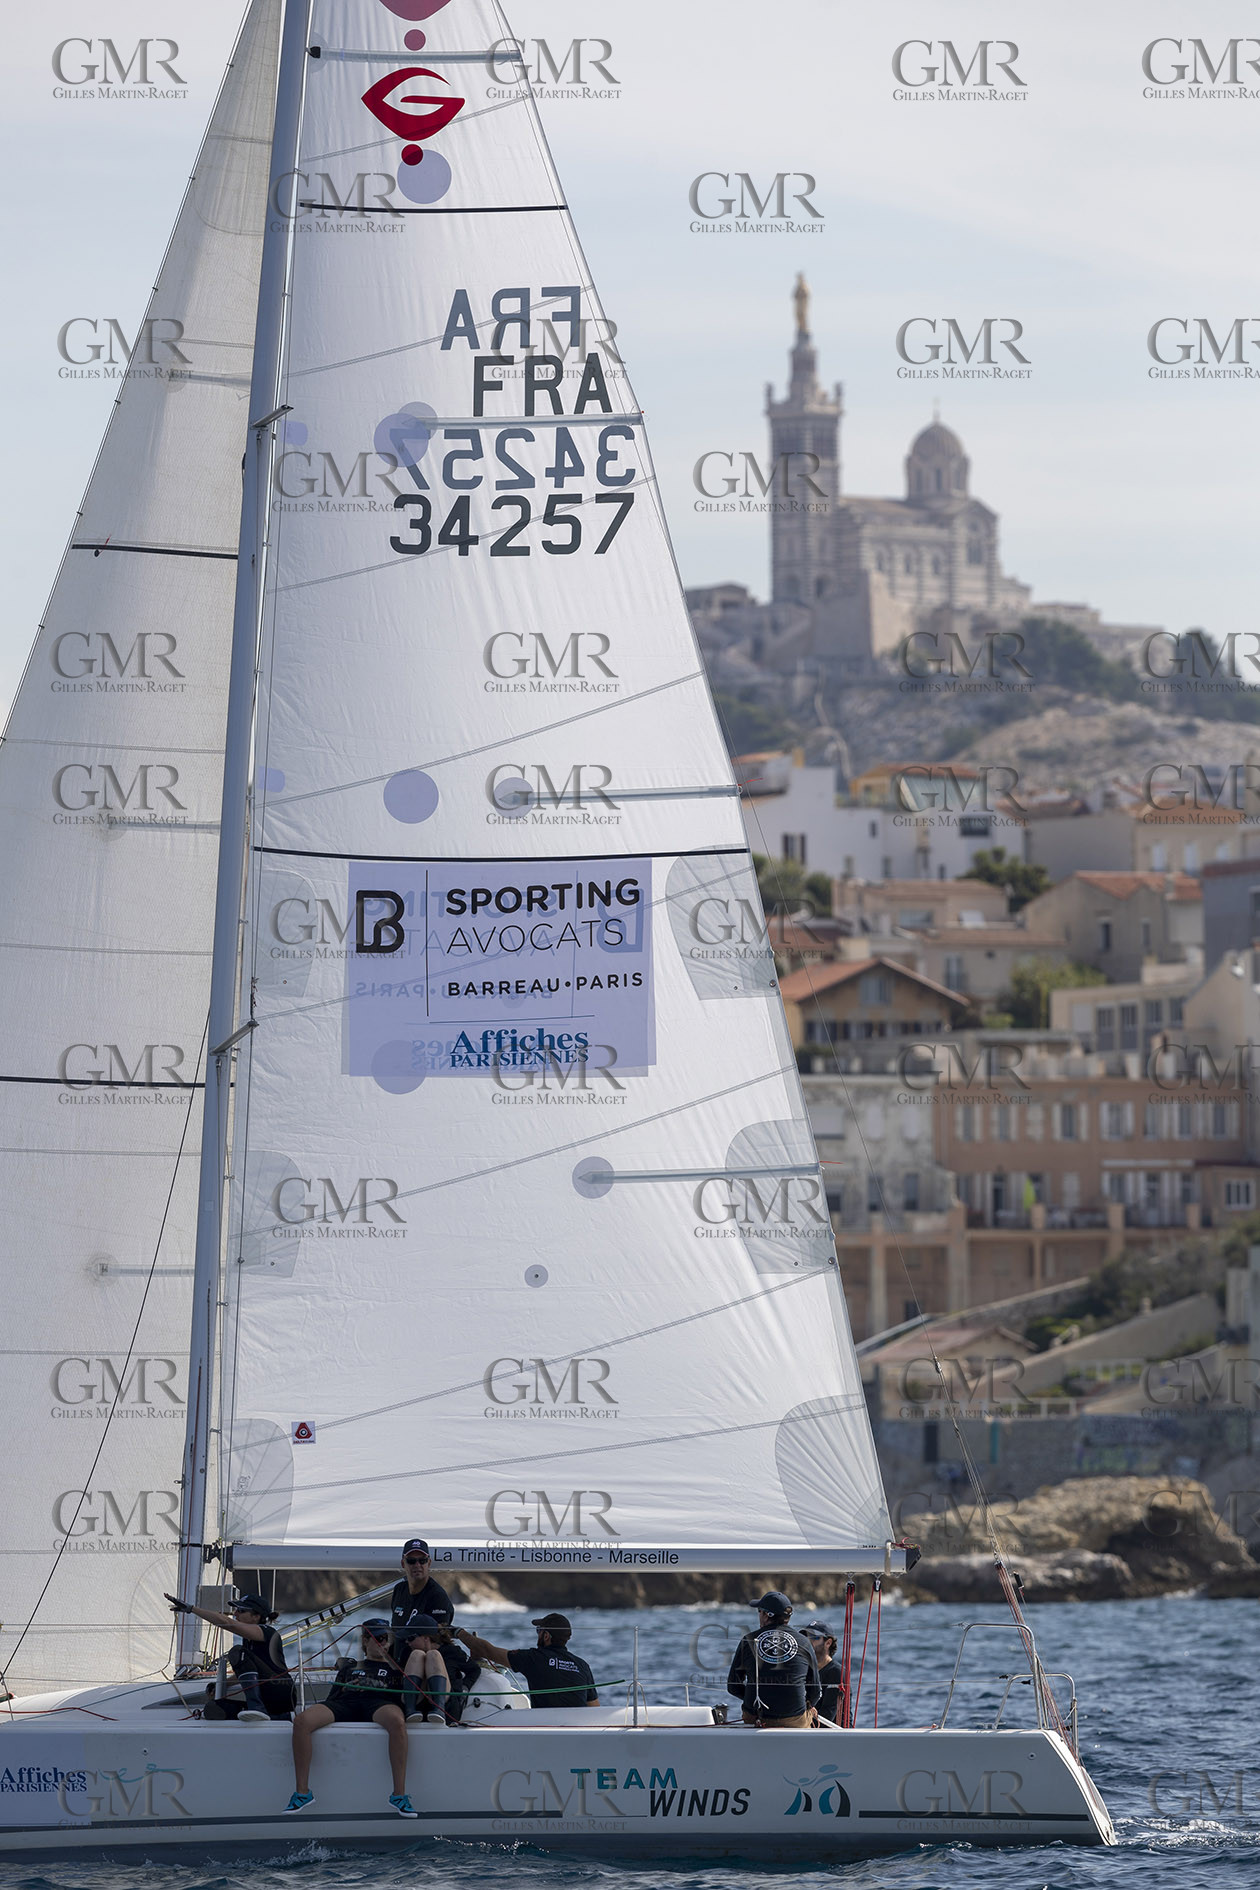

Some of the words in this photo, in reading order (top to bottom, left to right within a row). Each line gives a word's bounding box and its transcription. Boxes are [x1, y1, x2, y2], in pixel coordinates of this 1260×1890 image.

[473, 353, 613, 417] FRA
[390, 492, 635, 557] 34257
[446, 878, 641, 916] SPORTING
[446, 918, 624, 954] AVOCATS
[450, 1028, 589, 1055] Affiches
[450, 1050, 589, 1068] PARISIENNES
[434, 1548, 453, 1562] La
[458, 1548, 505, 1562] Trinité
[521, 1549, 591, 1563] Lisbonne
[609, 1550, 680, 1564] Marseille
[0, 1766, 87, 1784] Affiches
[1, 1783, 87, 1793] PARISIENNES
[570, 1767, 678, 1790] TEAM
[650, 1787, 751, 1817] WINDS
